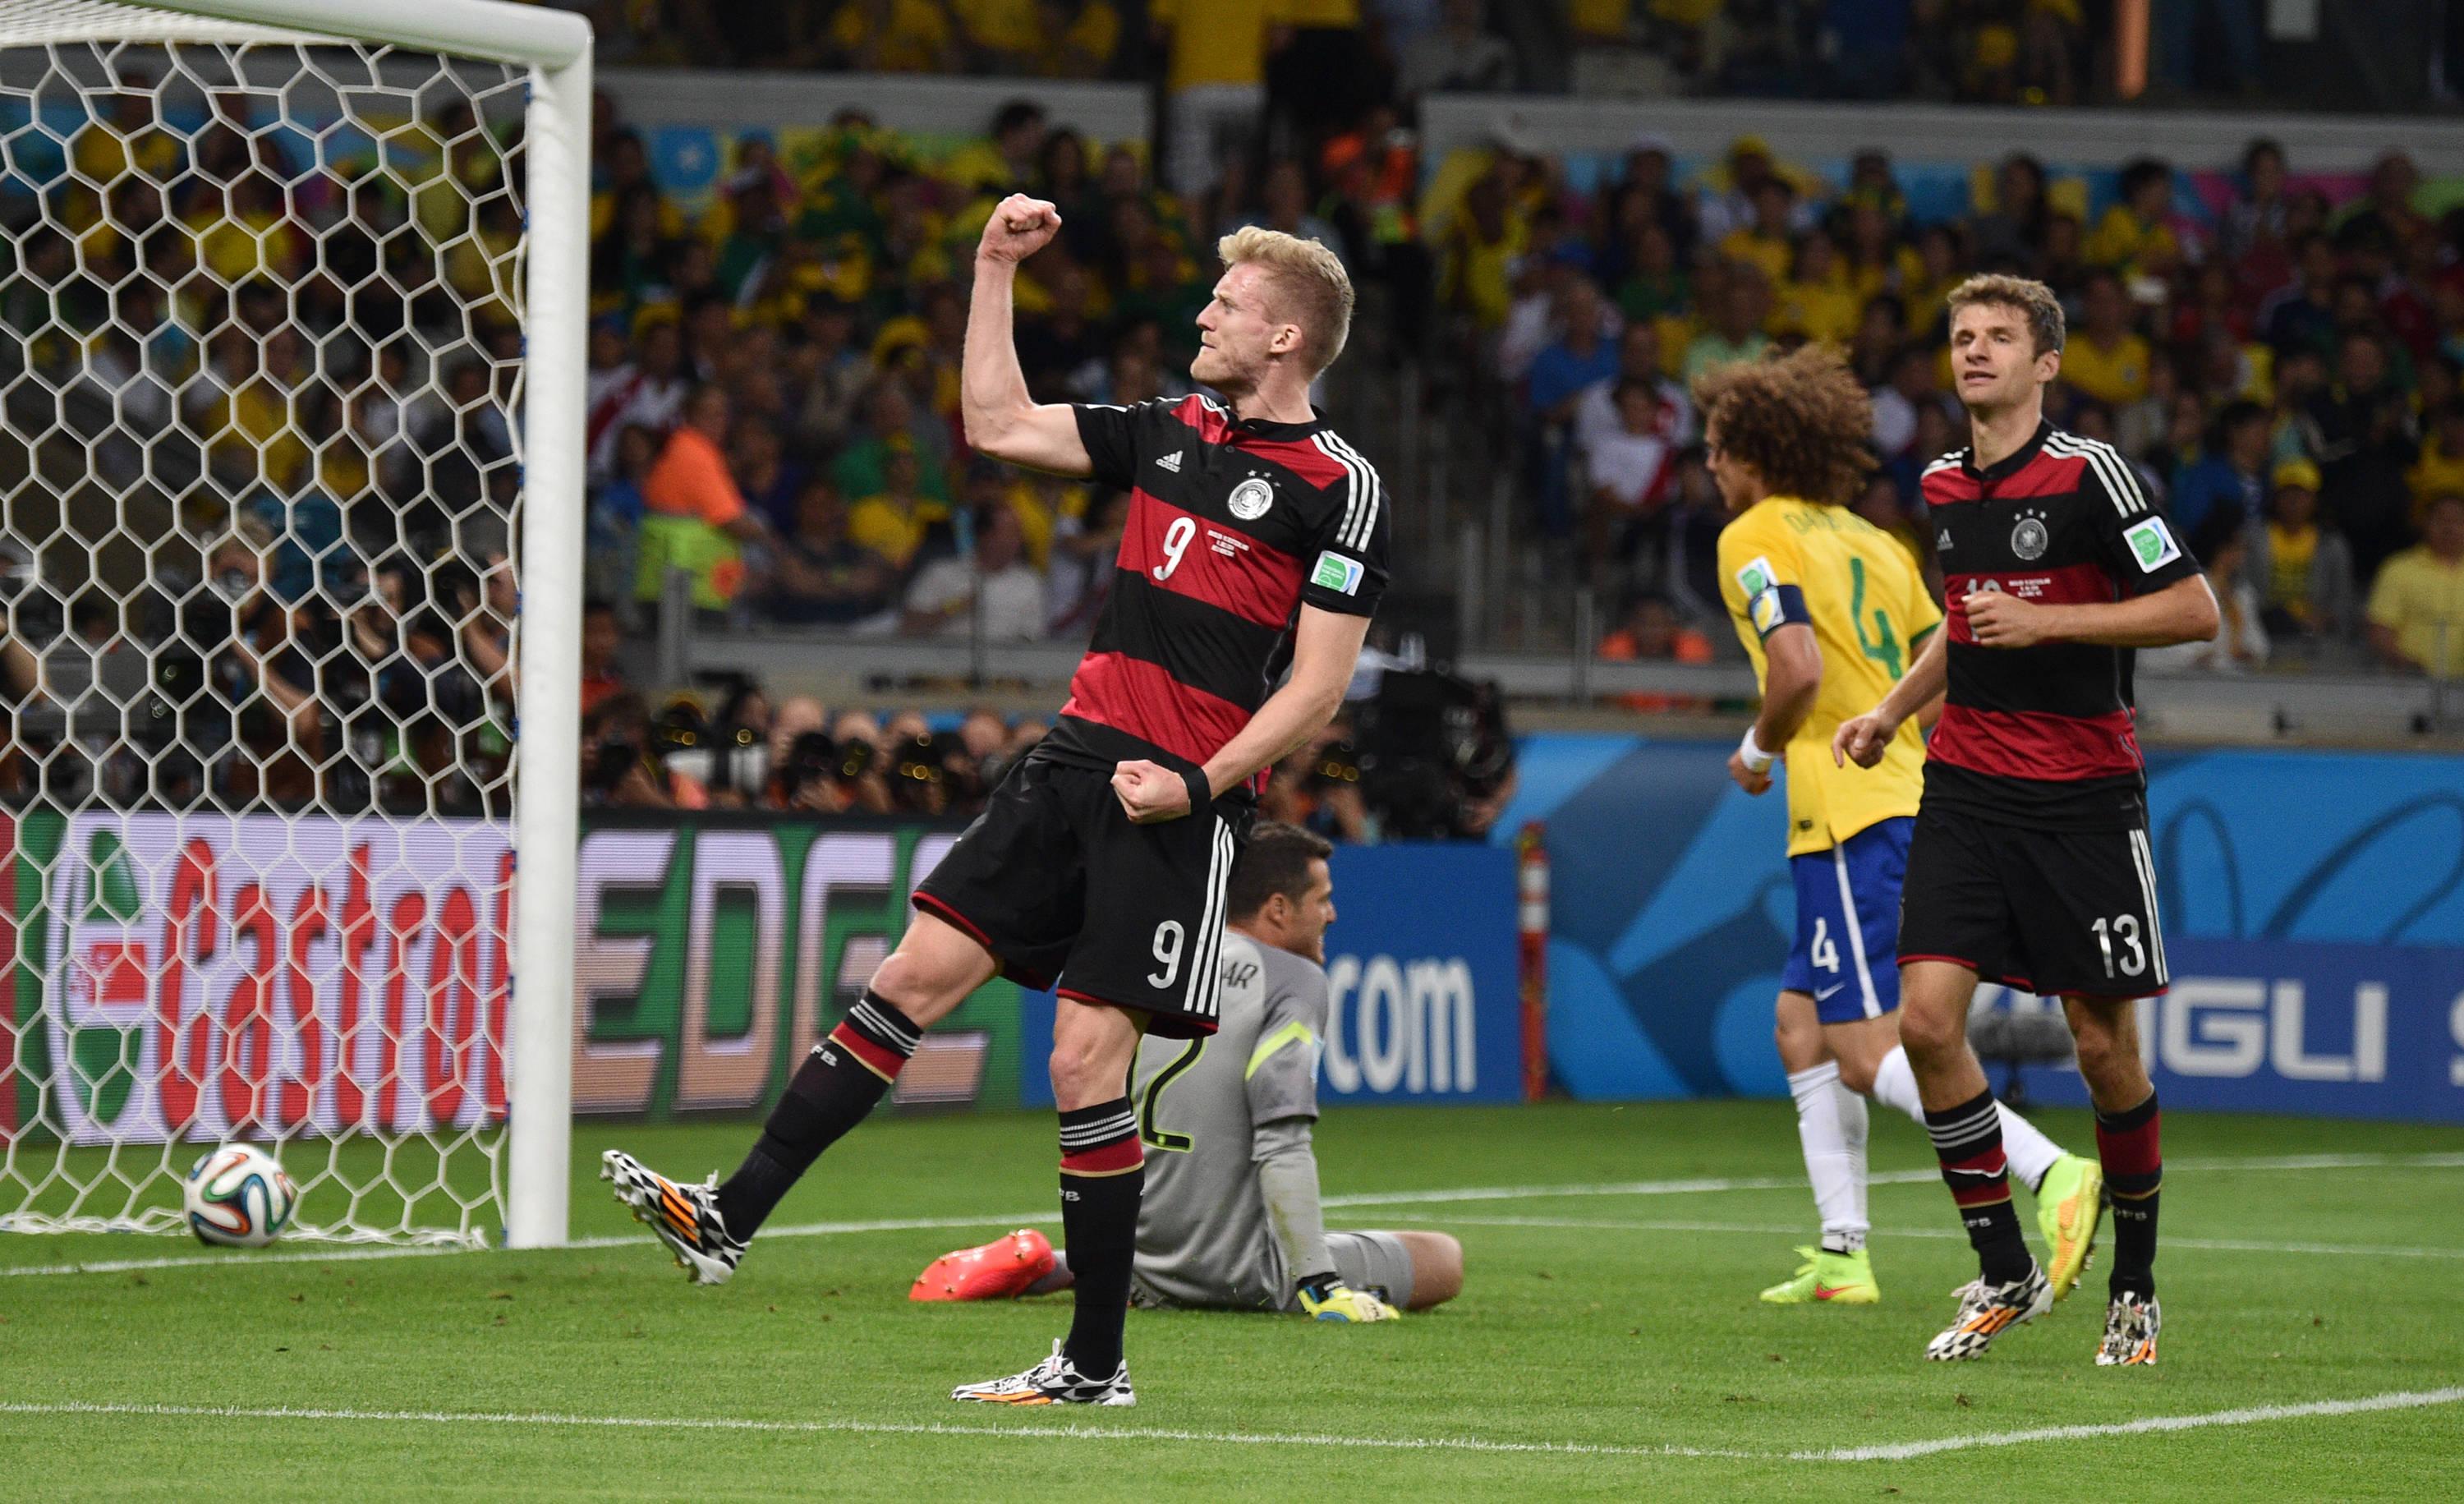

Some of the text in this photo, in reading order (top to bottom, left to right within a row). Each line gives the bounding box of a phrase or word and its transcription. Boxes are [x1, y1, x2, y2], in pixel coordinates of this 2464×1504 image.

[1153, 517, 1197, 582] 9
[1850, 558, 1903, 680] 4
[1147, 920, 1184, 989] 9
[1812, 917, 1840, 973] 4
[2091, 913, 2146, 978] 13
[158, 836, 516, 1129] Castrol
